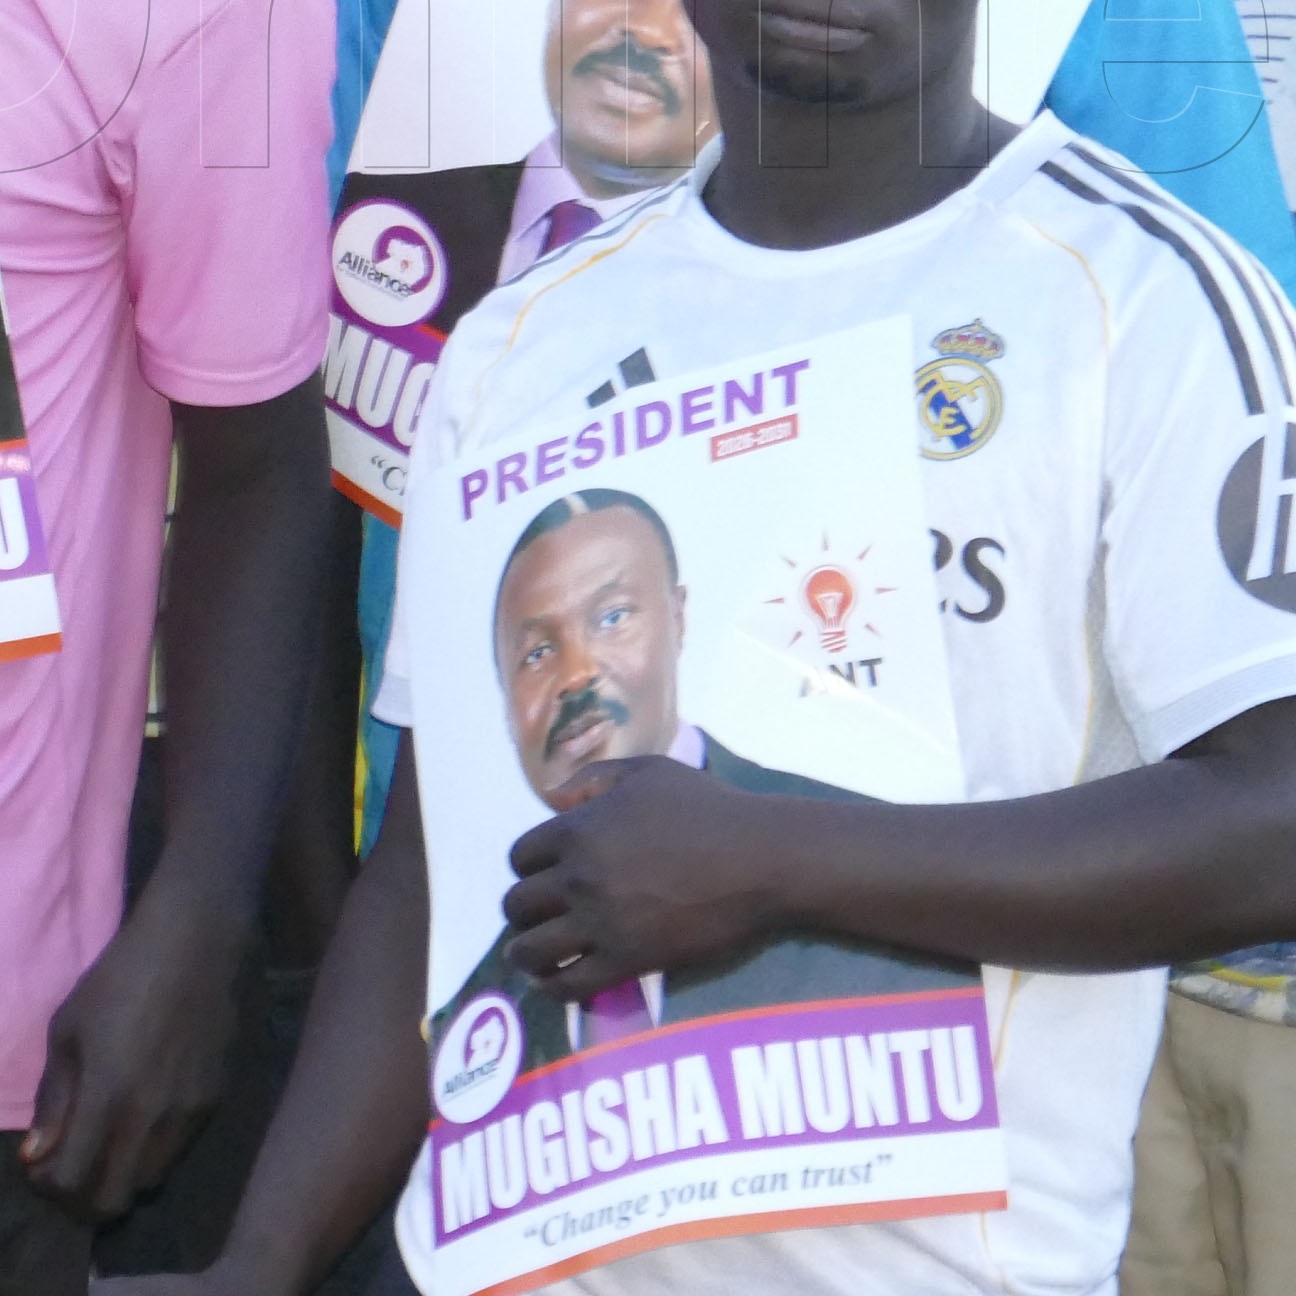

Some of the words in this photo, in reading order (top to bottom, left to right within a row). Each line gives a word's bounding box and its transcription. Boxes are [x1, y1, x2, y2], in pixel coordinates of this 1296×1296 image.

[339, 251, 412, 297] Alliance
[461, 358, 811, 521] PRESIDENT
[441, 1054, 730, 1234] MUGISHA
[731, 1025, 984, 1140] MUNTU
[658, 1179, 717, 1217] you
[731, 1171, 789, 1198] can
